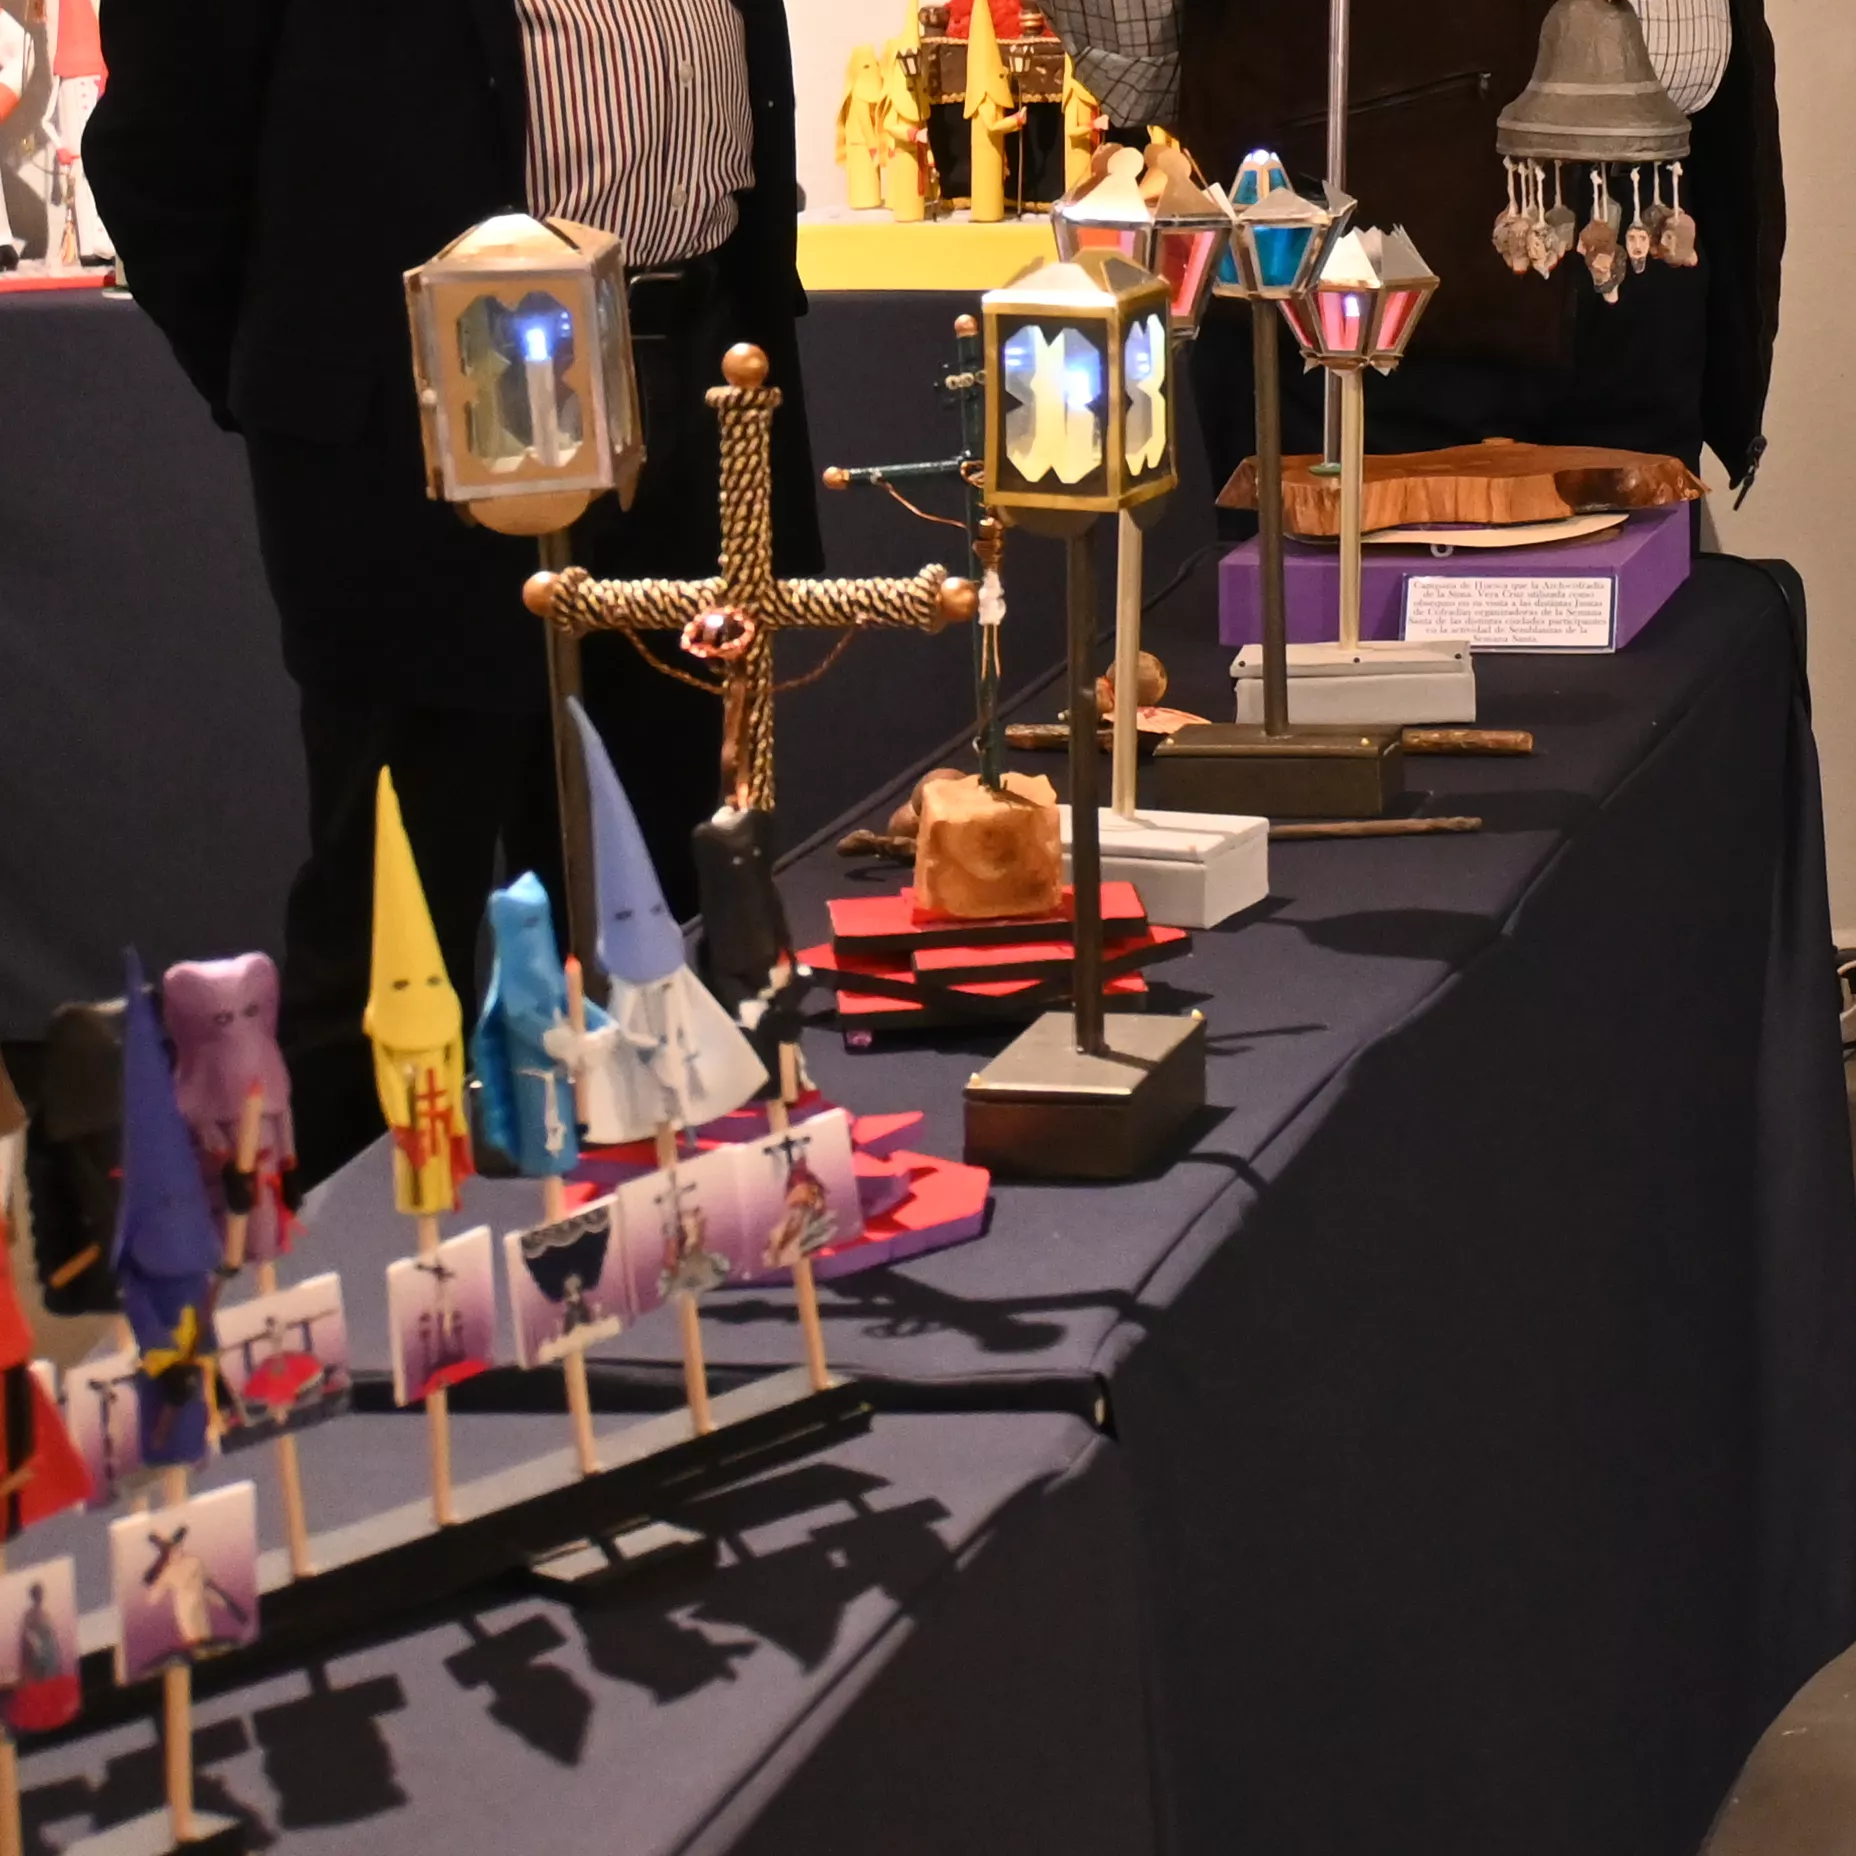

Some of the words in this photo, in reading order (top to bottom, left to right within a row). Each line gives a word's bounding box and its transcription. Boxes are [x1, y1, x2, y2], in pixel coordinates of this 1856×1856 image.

[1511, 582, 1528, 591] que
[1423, 590, 1436, 598] de
[1478, 590, 1498, 598] Vera
[1519, 599, 1531, 607] las
[1540, 608, 1552, 616] de
[1435, 617, 1447, 625] de
[1450, 617, 1462, 625] las
[1565, 626, 1577, 634] de
